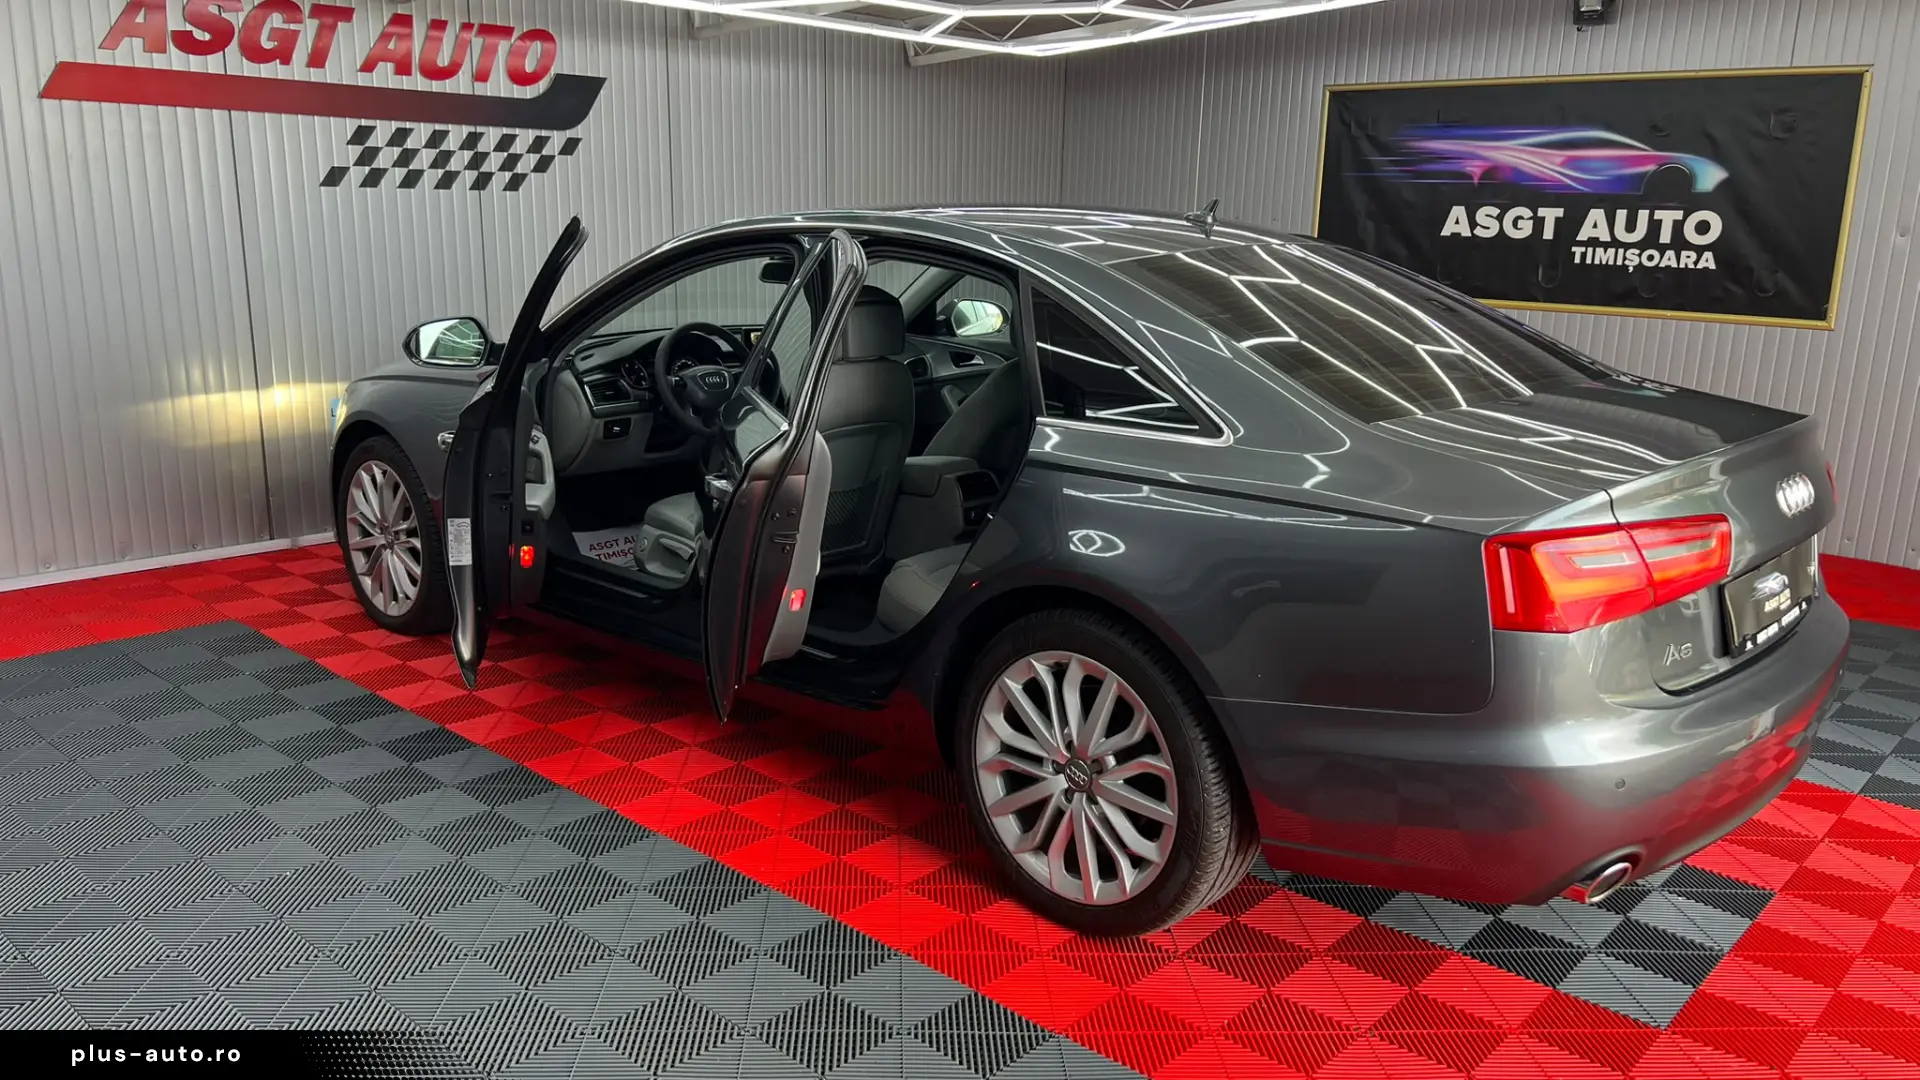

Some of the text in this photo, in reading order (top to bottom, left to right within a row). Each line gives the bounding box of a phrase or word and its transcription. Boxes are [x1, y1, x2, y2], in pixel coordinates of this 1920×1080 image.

[98, 0, 557, 87] ASGT AUTO
[1439, 205, 1723, 246] ASGT AUTO
[1571, 246, 1717, 273] TIMIȘOARA
[588, 538, 620, 552] ASGT
[1663, 643, 1693, 666] A6
